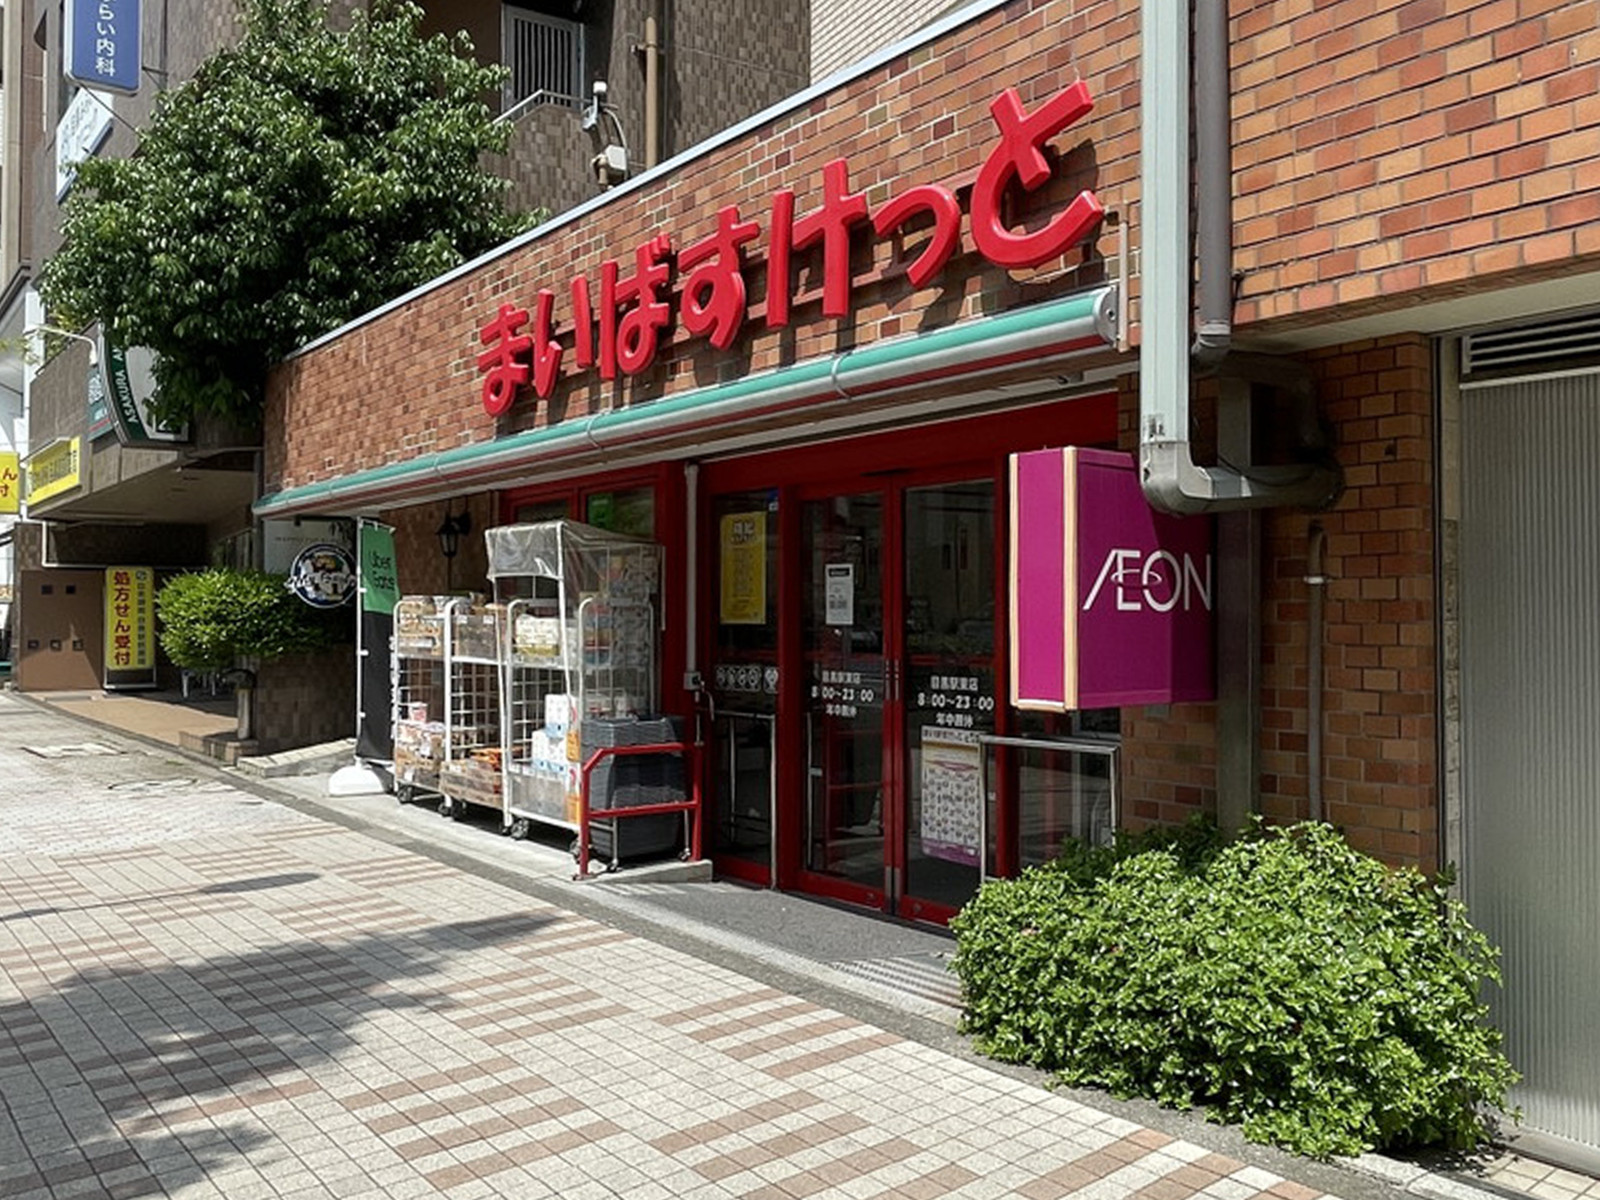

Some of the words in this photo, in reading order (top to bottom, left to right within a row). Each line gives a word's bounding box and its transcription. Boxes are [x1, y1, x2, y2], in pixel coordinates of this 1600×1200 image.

[96, 0, 115, 76] らい内科
[477, 79, 1105, 417] まいばすけっと
[115, 369, 139, 423] ASAKURA
[114, 571, 131, 665] 処方せん受付
